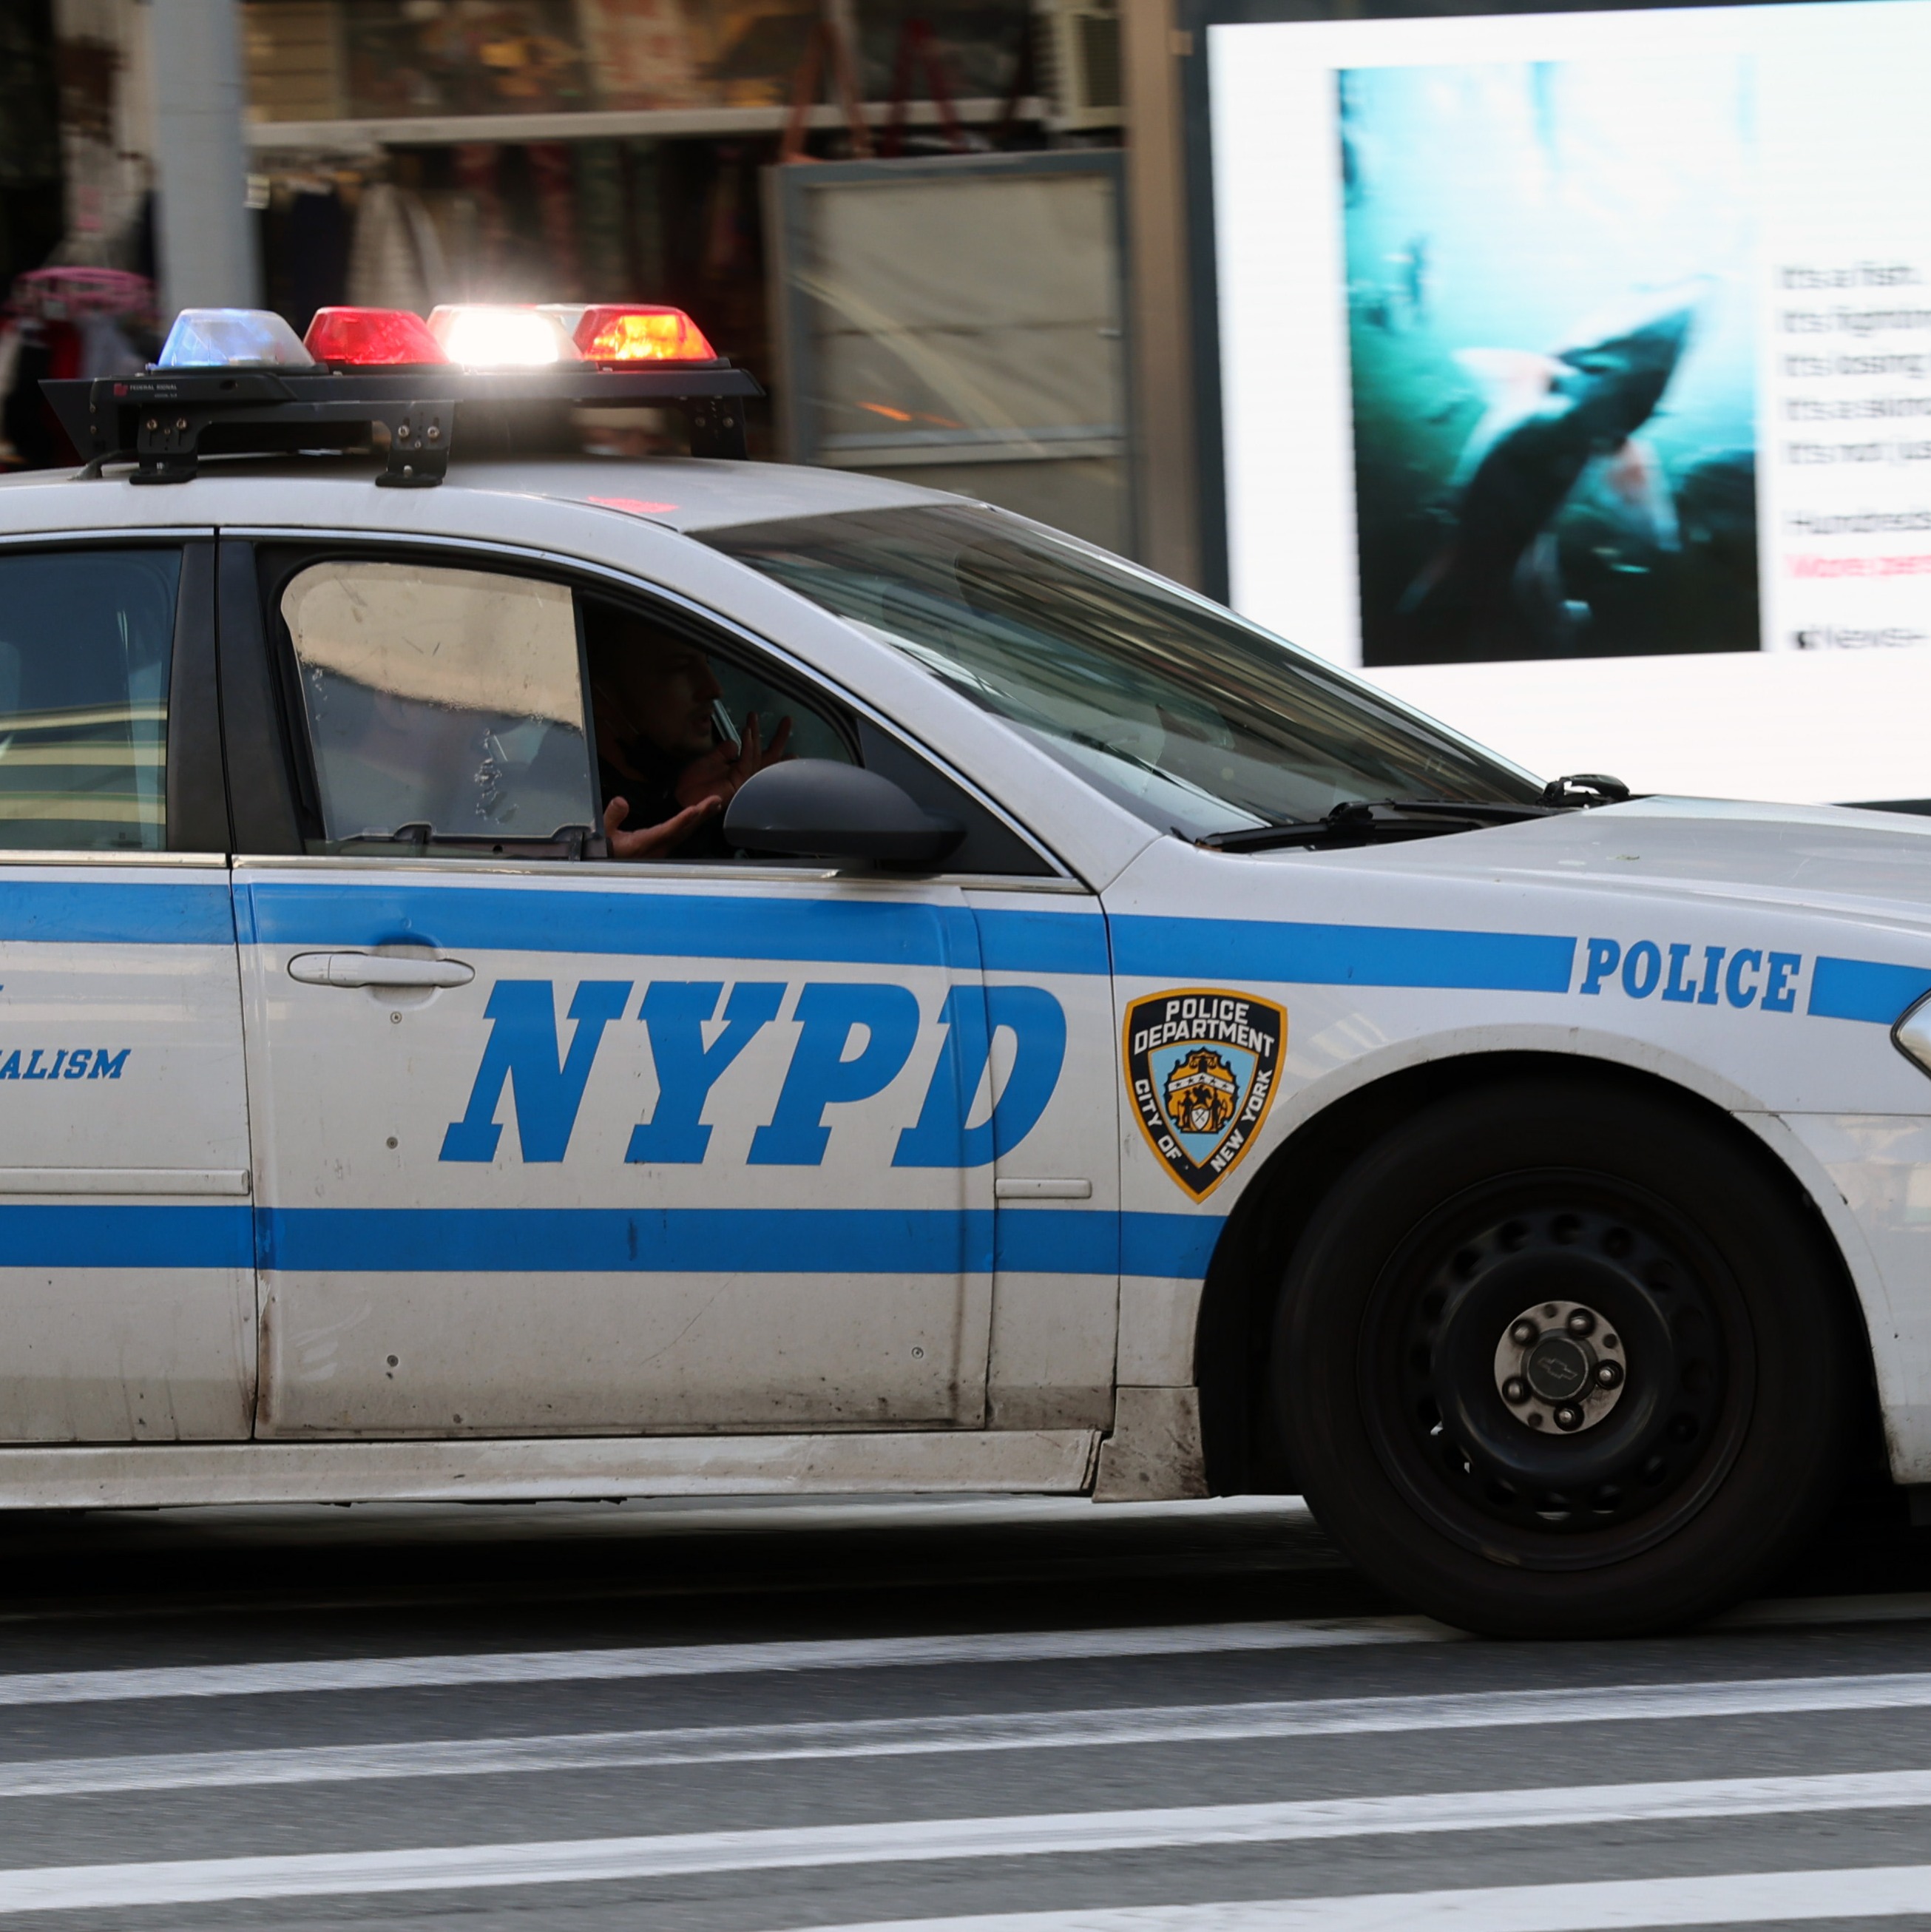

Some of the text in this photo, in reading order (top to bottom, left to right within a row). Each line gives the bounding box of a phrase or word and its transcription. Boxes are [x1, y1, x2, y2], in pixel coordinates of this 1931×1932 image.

[1166, 998, 1250, 1024] POLICE
[1580, 937, 1802, 1013] POLICE
[0, 1049, 132, 1080] ALISM
[439, 980, 1067, 1168] NYPD
[1133, 1019, 1275, 1058] DEPARTMENT
[1134, 1078, 1183, 1161] CITY OF
[1209, 1069, 1274, 1172] NEW YORK
